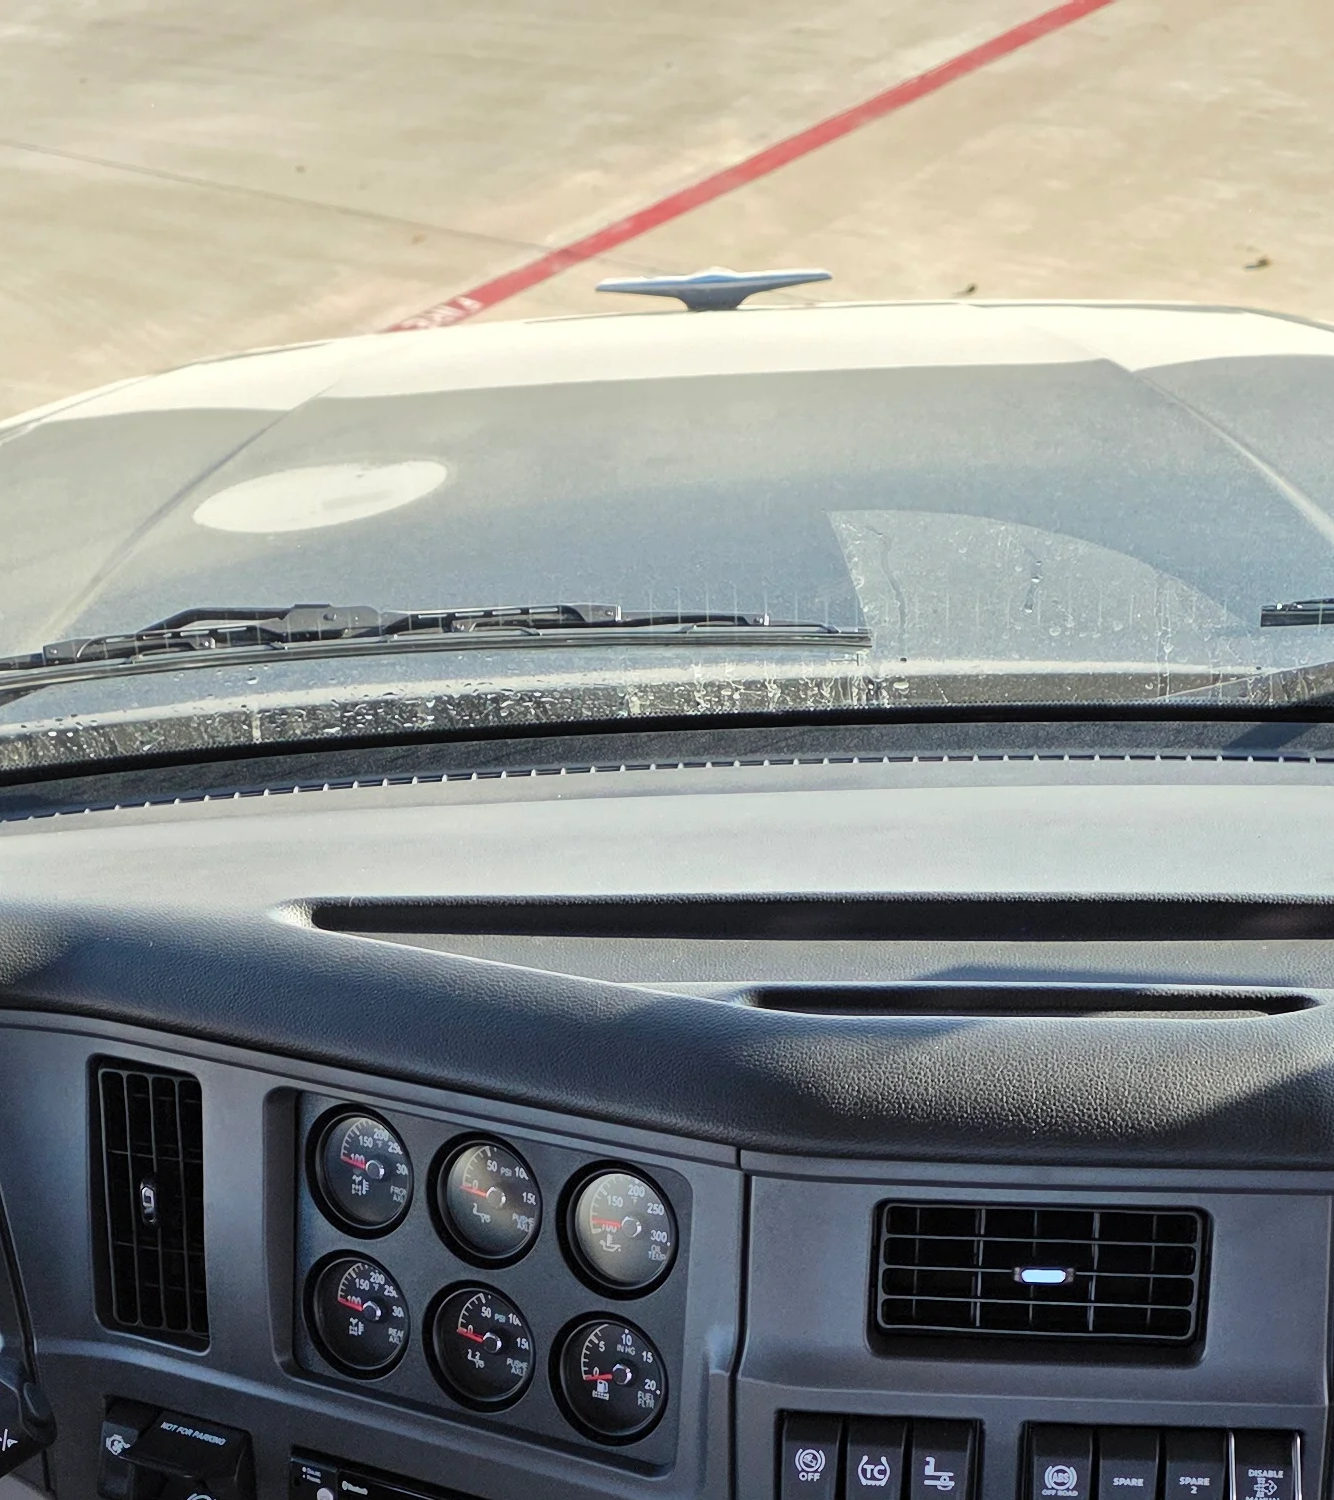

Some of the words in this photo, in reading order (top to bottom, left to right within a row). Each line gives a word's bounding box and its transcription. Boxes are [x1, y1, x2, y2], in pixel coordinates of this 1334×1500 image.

[373, 1128, 389, 1141] 200
[359, 1136, 374, 1148] 150
[486, 1160, 497, 1172] 50
[500, 1167, 512, 1177] PSI
[628, 1184, 645, 1197] 200
[607, 1194, 623, 1208] 150
[647, 1202, 664, 1216] 250
[650, 1230, 667, 1243] 300
[648, 1250, 667, 1260] TEMP
[355, 1277, 369, 1290] 150
[369, 1271, 385, 1285] 200
[481, 1306, 492, 1318] 50
[494, 1313, 506, 1323] PSI
[621, 1334, 632, 1345] 10
[598, 1341, 606, 1352] 5
[616, 1344, 624, 1353] IN
[625, 1346, 636, 1355] HG
[641, 1351, 653, 1363] 15
[593, 1366, 599, 1376] 0
[644, 1379, 656, 1391] 20
[637, 1391, 654, 1401] FUEL
[637, 1399, 655, 1409] FLTR
[161, 1422, 175, 1432] NOT
[176, 1426, 193, 1436] FOR
[192, 1430, 226, 1446] PARKING
[798, 1472, 821, 1482] OFF
[863, 1465, 885, 1478] TC
[1052, 1471, 1070, 1483] ABS
[1248, 1469, 1284, 1478] DISABLE
[1113, 1477, 1144, 1487] SPARE
[1179, 1476, 1210, 1486] SPARE
[1057, 1489, 1078, 1497] ROAD
[1190, 1486, 1197, 1494] 2
